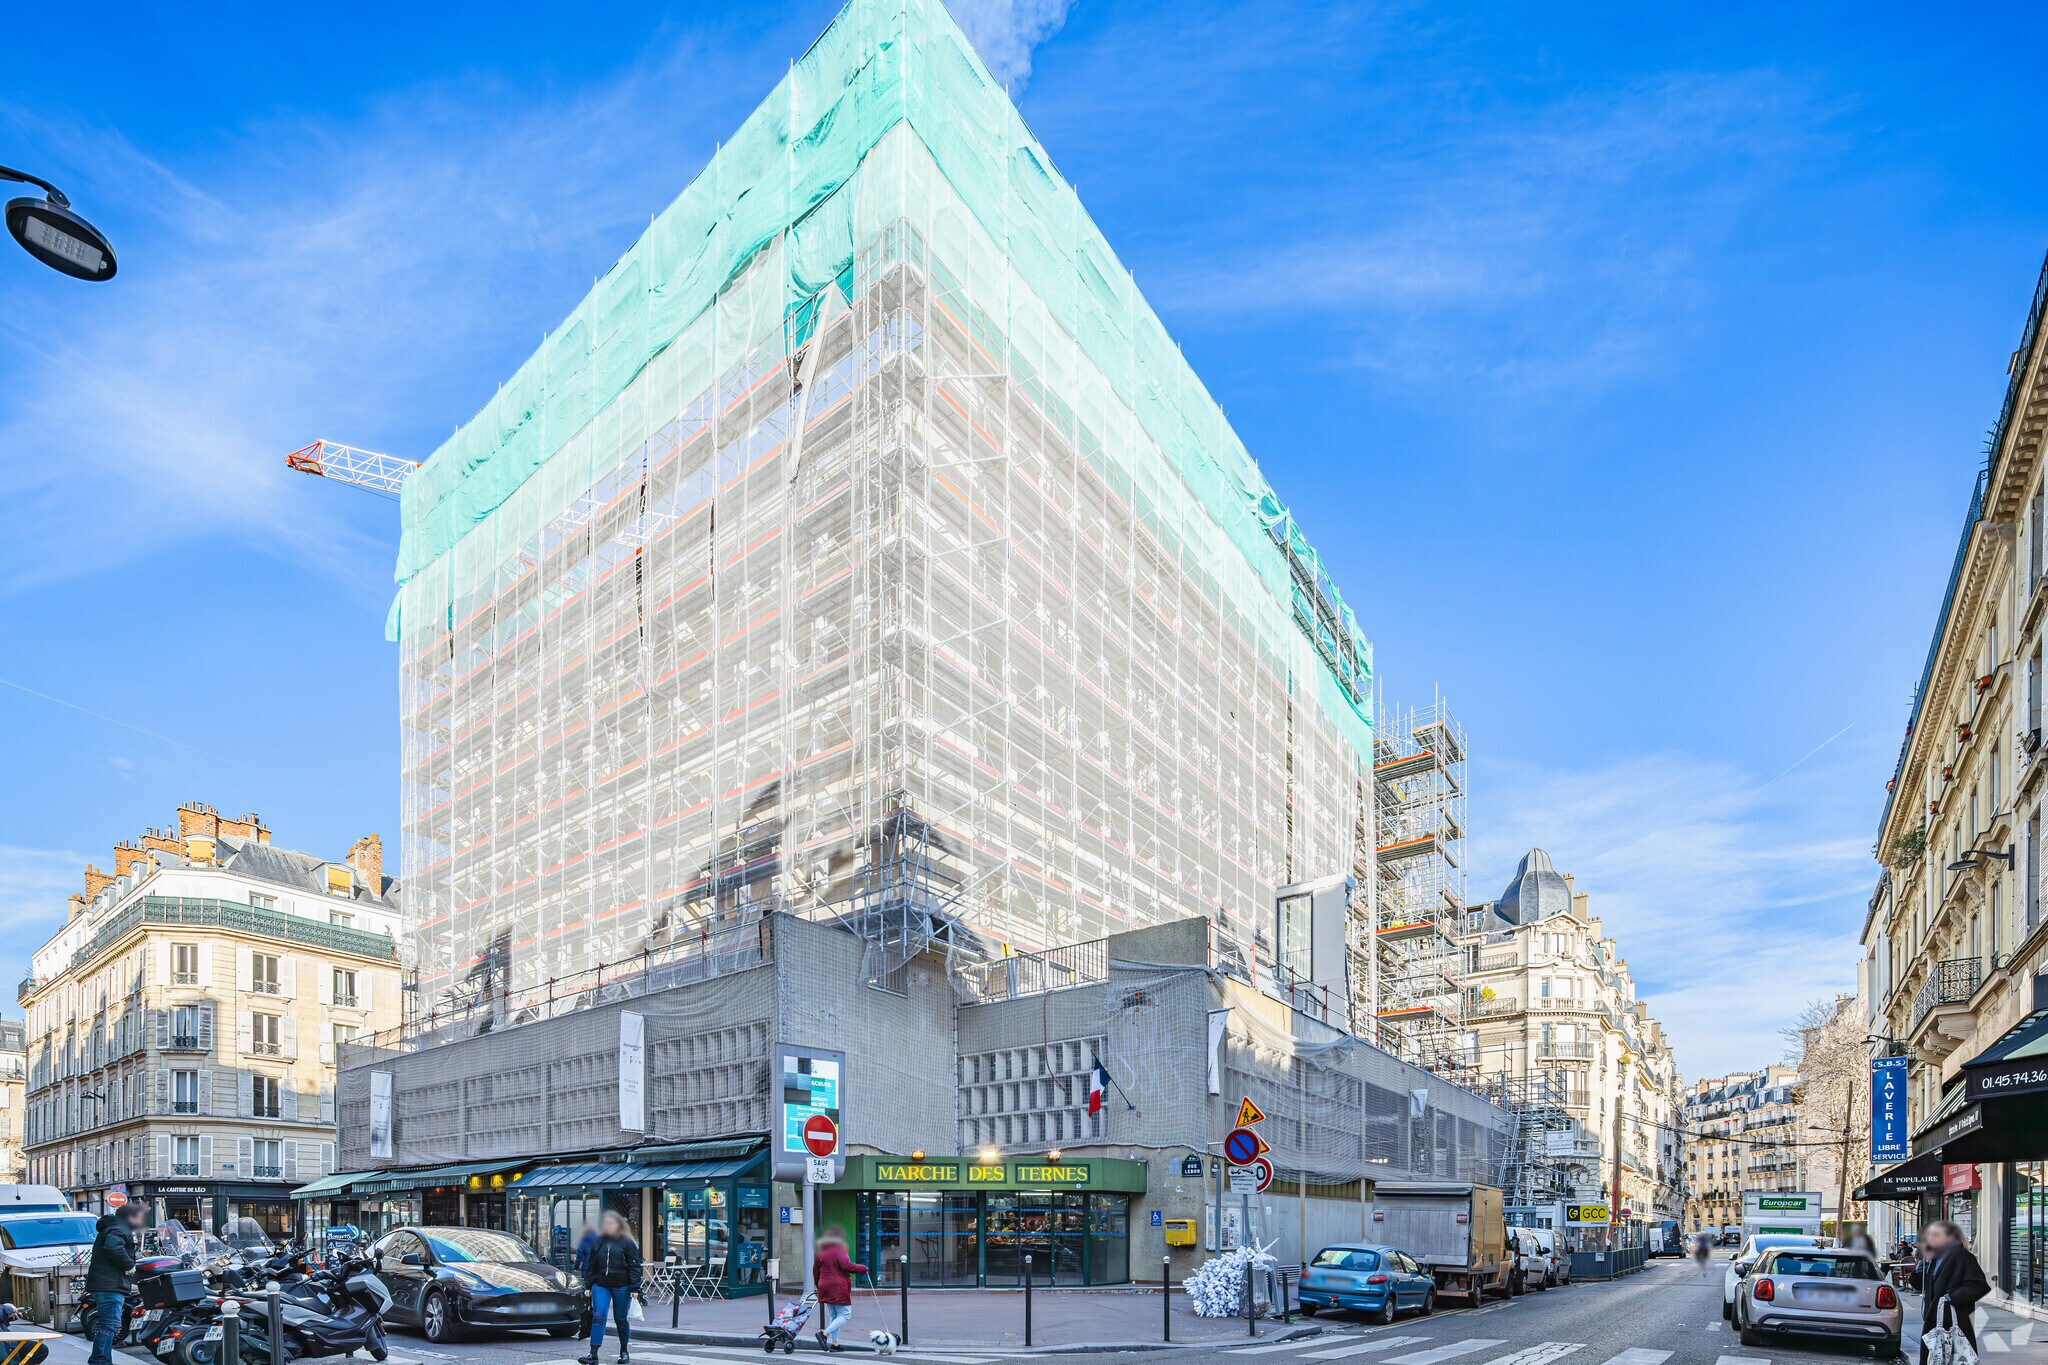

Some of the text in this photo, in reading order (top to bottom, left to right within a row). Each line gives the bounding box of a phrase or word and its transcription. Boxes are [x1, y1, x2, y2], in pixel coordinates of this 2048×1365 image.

[1884, 1072, 1895, 1141] LAVERIE
[878, 1165, 1089, 1182] MARCHE DES TERNES
[1895, 1175, 1938, 1184] POPULAIRE
[1762, 1199, 1803, 1208] Europcar
[1582, 1208, 1606, 1219] GCC
